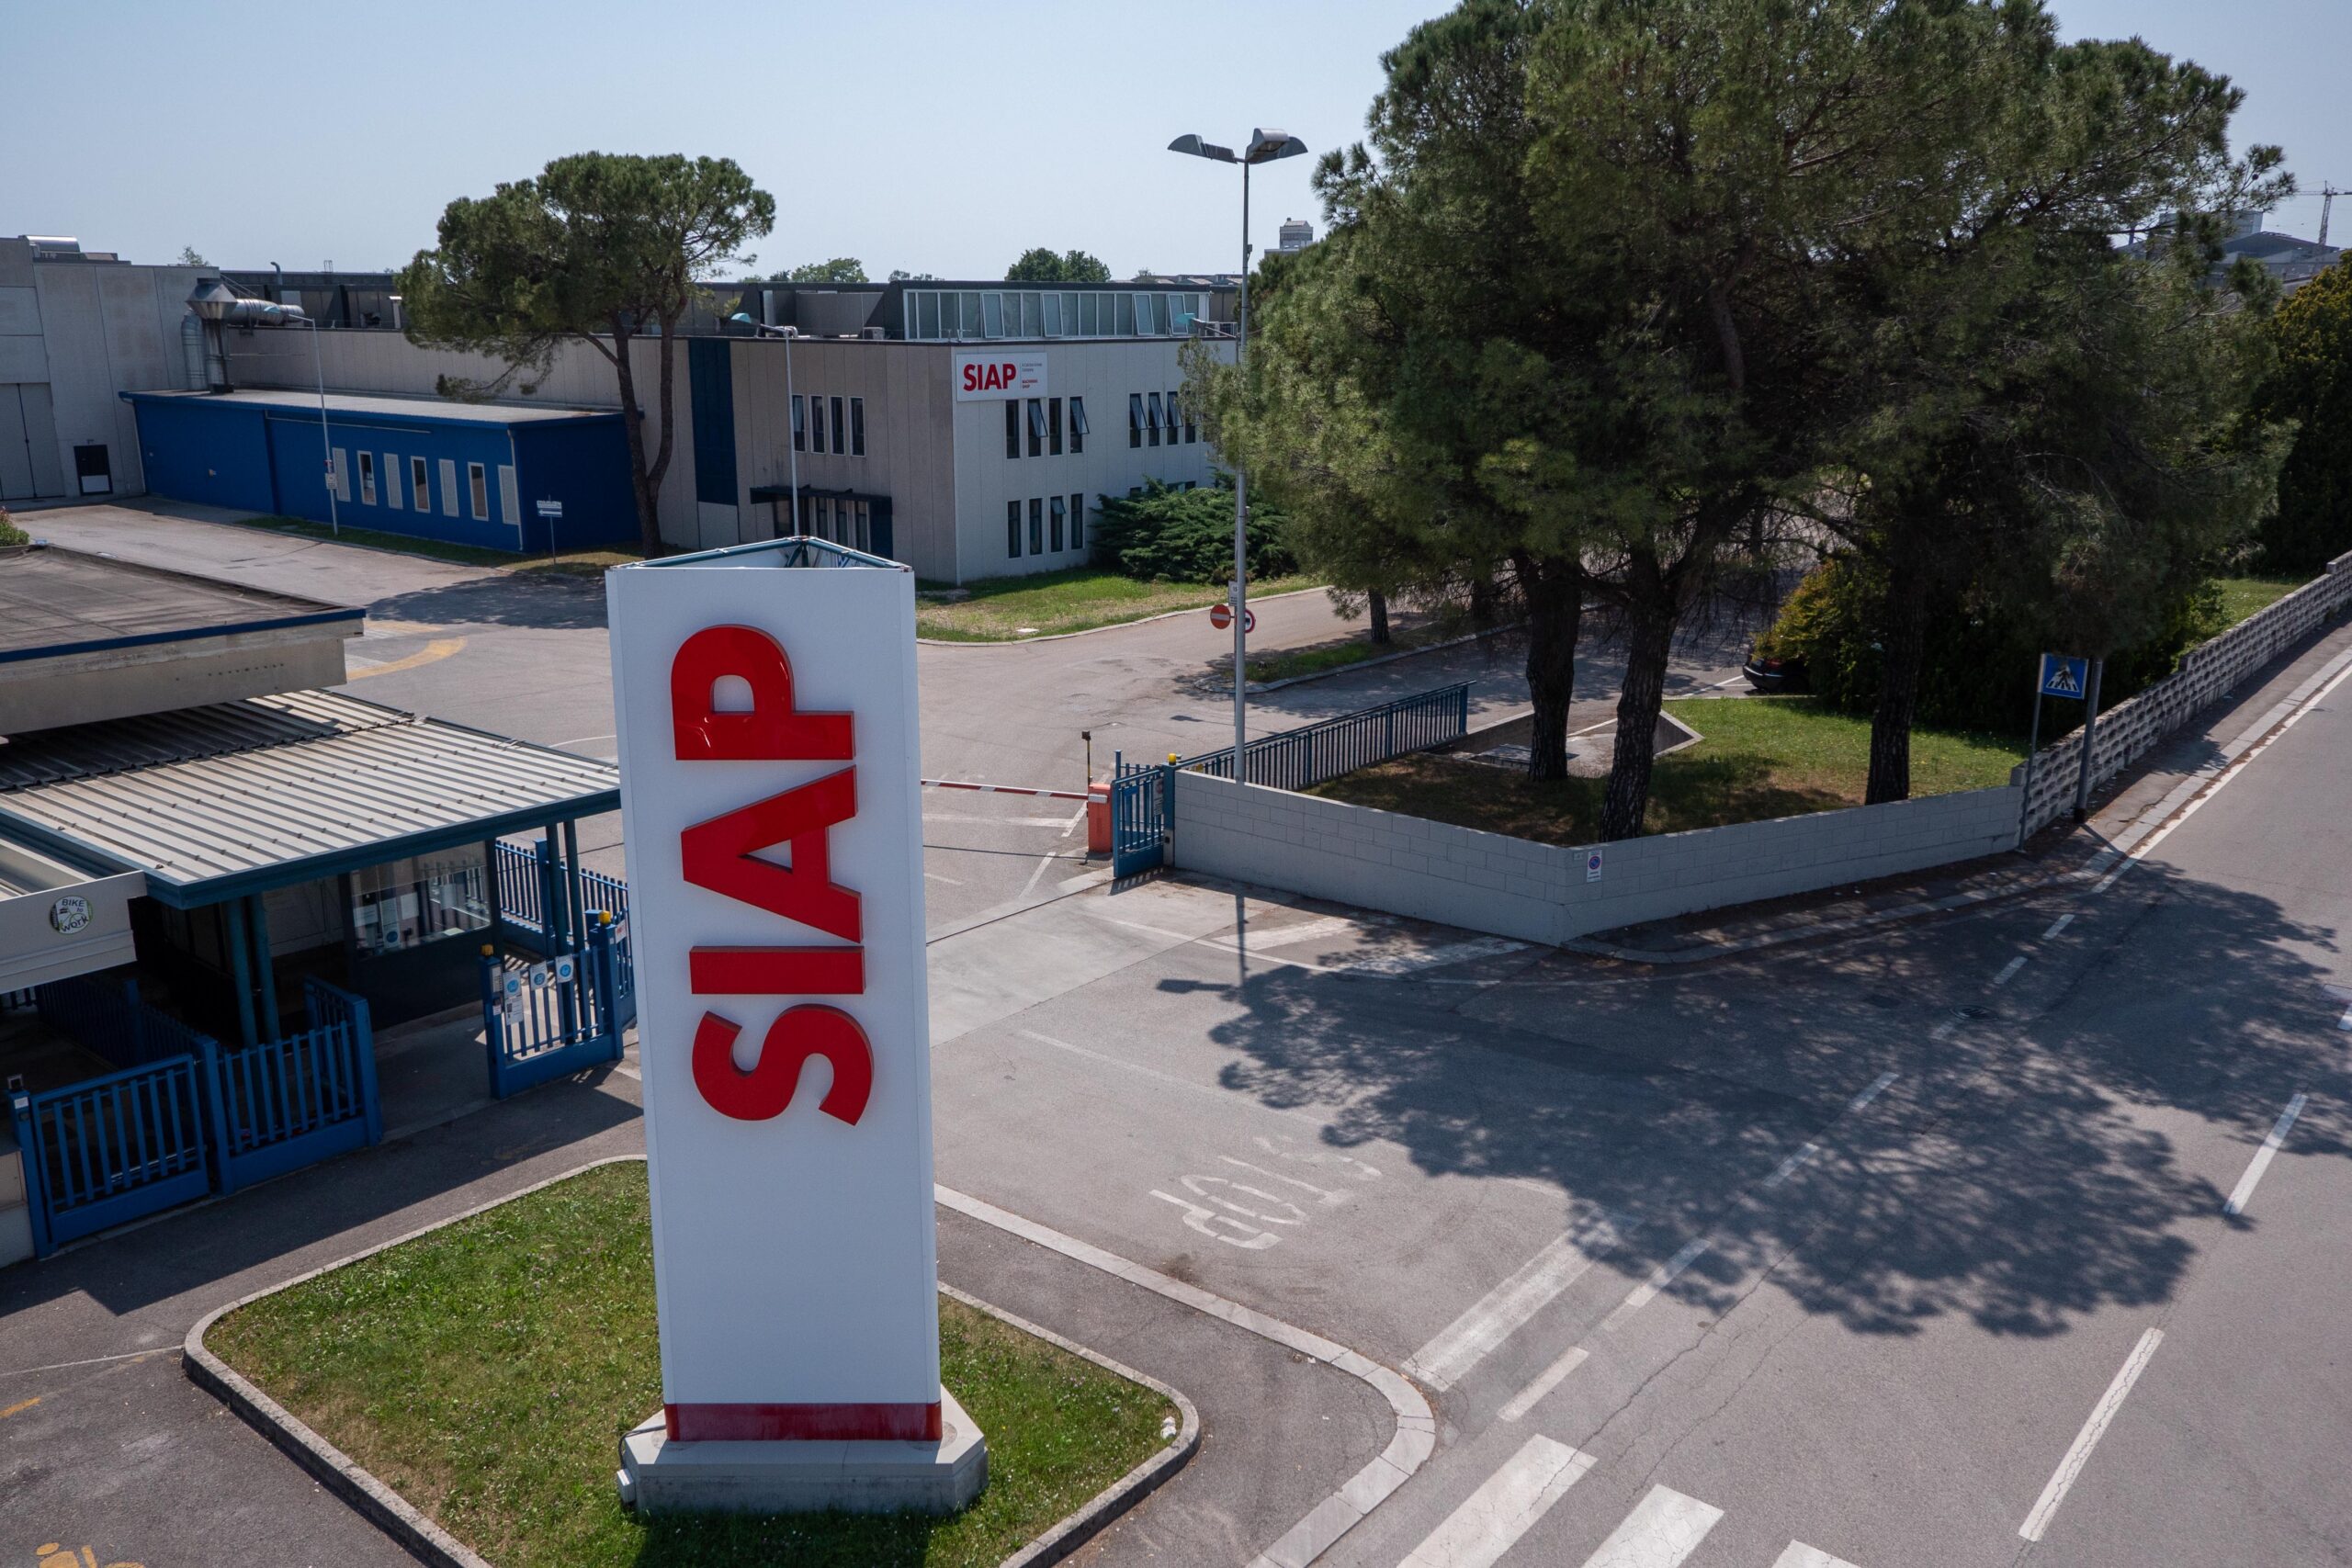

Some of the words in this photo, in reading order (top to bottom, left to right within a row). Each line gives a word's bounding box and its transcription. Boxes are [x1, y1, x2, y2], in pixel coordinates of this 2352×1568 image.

[963, 364, 1017, 391] SIAP
[670, 624, 875, 1126] SIAP
[62, 898, 85, 907] BIKE
[62, 915, 89, 931] work
